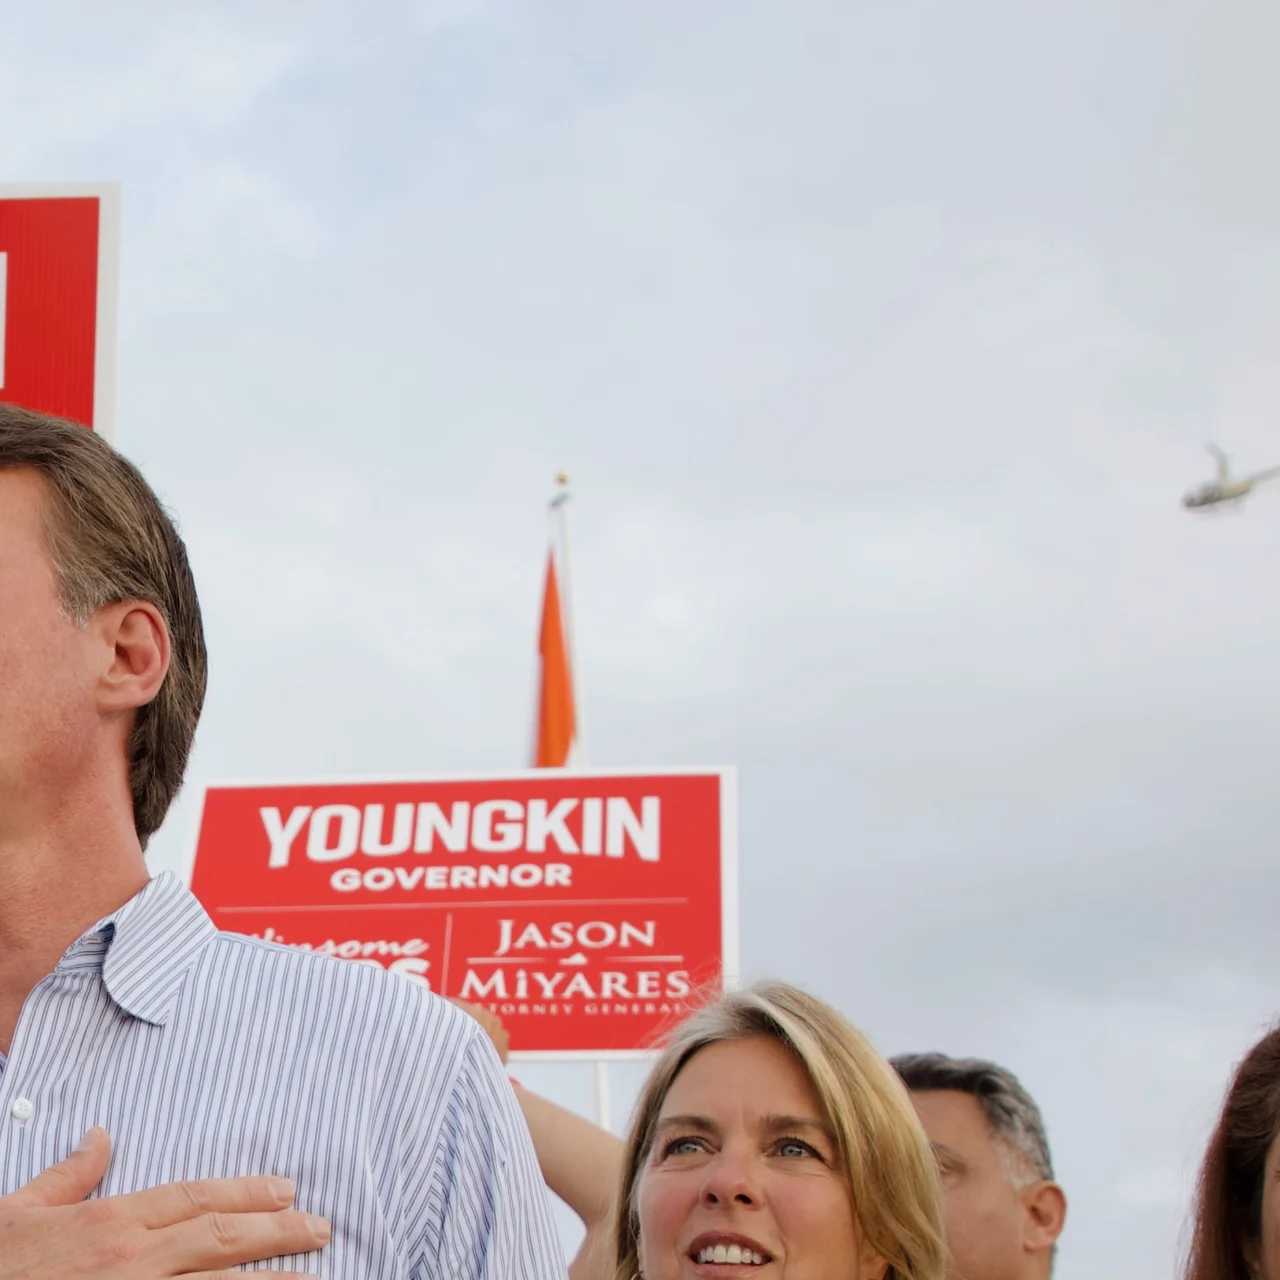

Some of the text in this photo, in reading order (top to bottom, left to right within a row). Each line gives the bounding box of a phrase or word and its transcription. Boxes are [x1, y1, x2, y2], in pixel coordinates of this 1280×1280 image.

[259, 796, 661, 869] YOUNGKIN
[330, 863, 572, 892] GOVERNOR
[494, 919, 656, 957] JASON
[472, 1002, 684, 1016] TORNEY GENERAL
